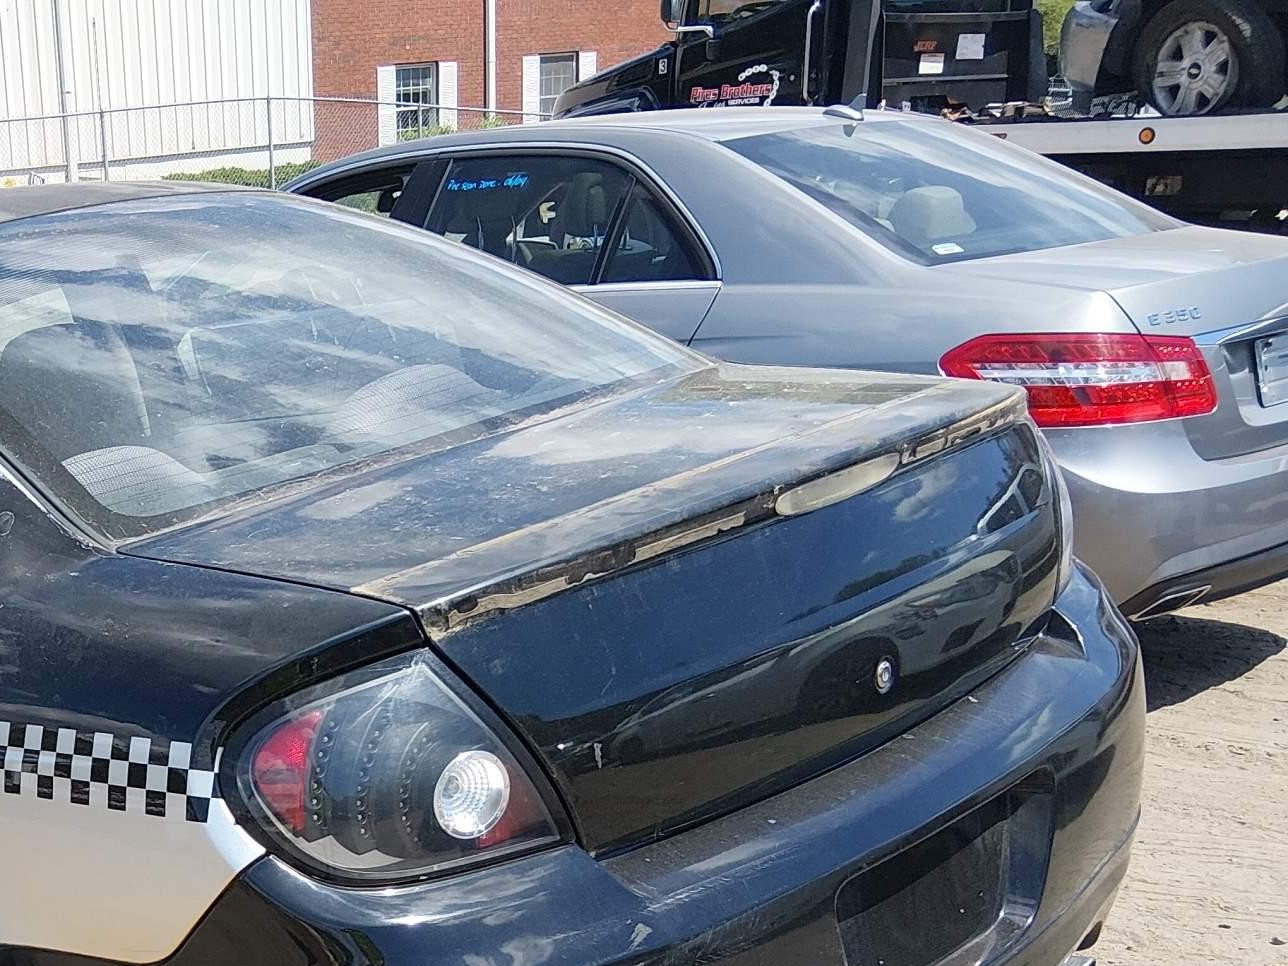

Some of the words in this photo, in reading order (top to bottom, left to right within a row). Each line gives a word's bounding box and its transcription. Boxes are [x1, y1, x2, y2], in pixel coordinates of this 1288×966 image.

[720, 83, 773, 99] Brothers
[1147, 313, 1161, 326] E
[1162, 307, 1201, 324] 350
